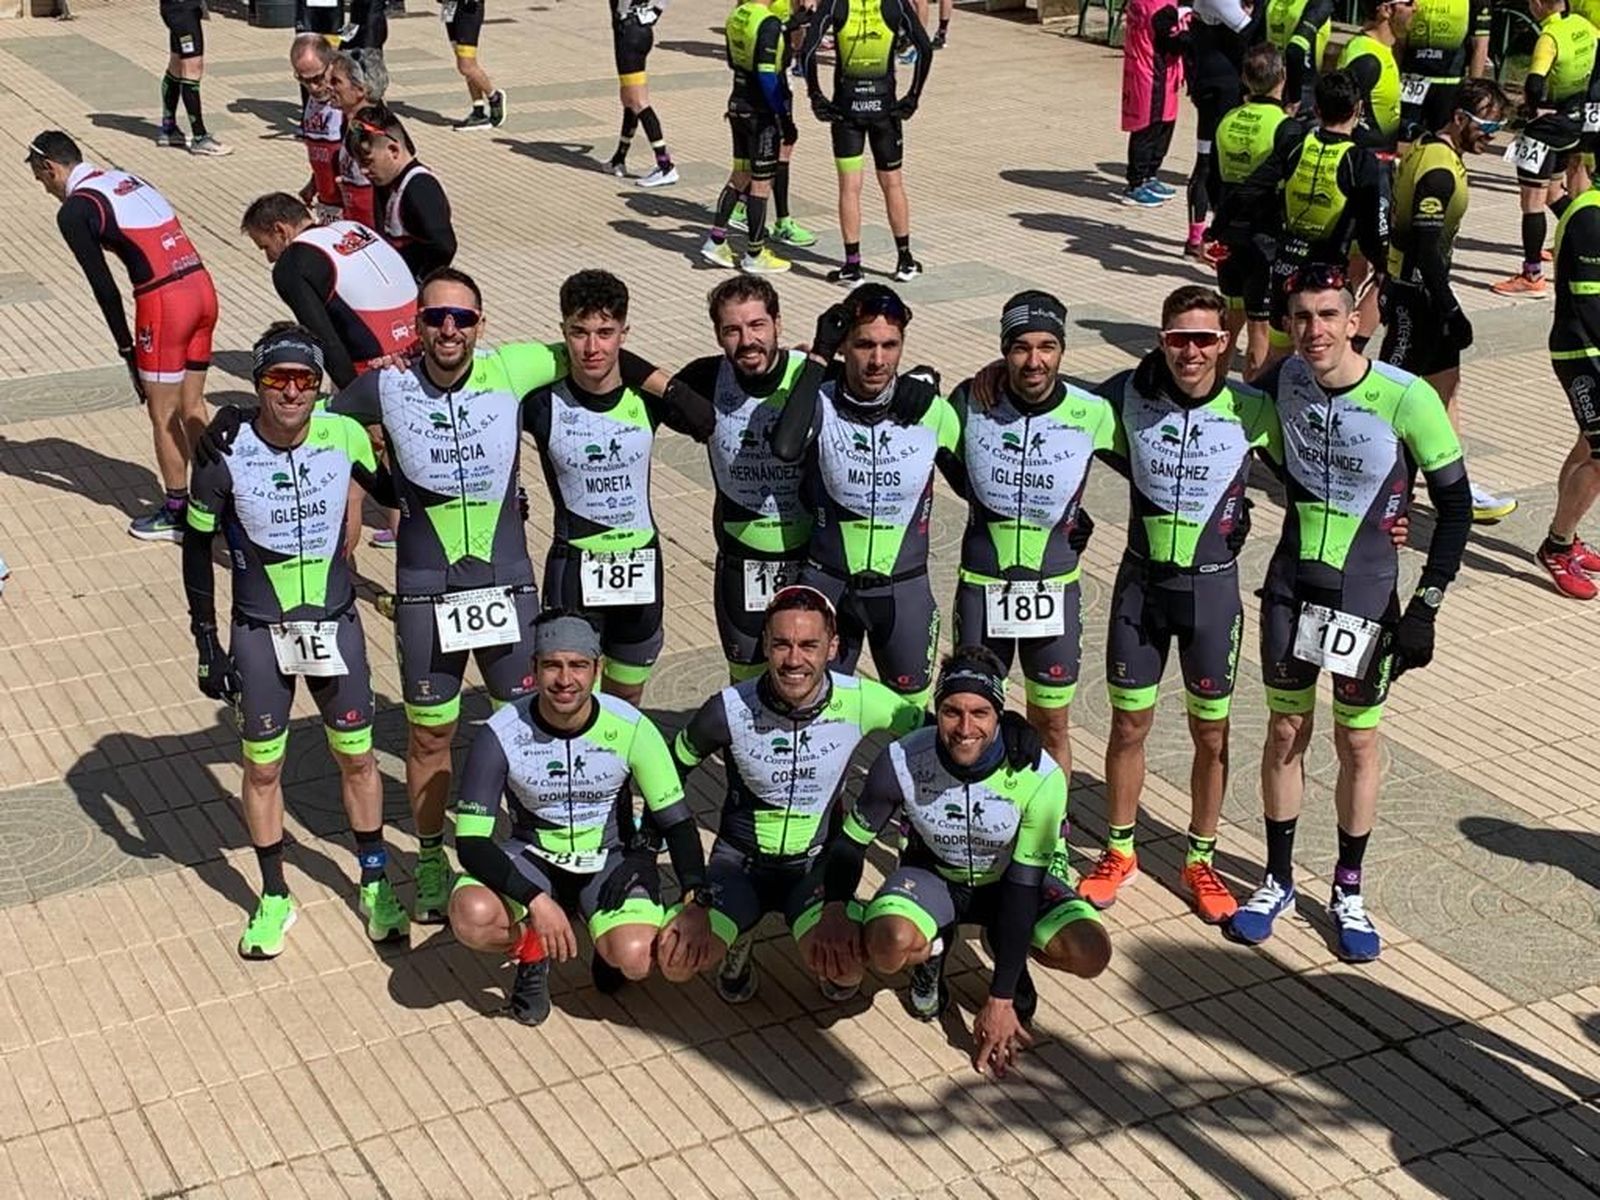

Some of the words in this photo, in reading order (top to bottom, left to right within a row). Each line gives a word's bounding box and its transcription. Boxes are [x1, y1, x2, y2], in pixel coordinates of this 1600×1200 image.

[1514, 143, 1539, 164] 13A
[408, 422, 422, 435] La
[430, 443, 485, 464] MURCIA
[978, 436, 990, 451] La
[566, 457, 578, 468] La
[729, 464, 799, 482] HERNÁNDEZ
[1150, 458, 1210, 481] SÁNCHEZ
[586, 475, 632, 493] MORETA
[848, 468, 901, 486] MATEOS
[991, 466, 1055, 490] IGLESIAS
[252, 486, 265, 498] La
[271, 500, 327, 524] IGLESIAS
[592, 564, 645, 589] 18F
[447, 601, 508, 634] 18C
[997, 594, 1055, 621] 18D
[294, 635, 331, 660] 1E
[1318, 624, 1357, 657] 1D
[771, 767, 816, 784] COSME
[924, 812, 935, 823] La
